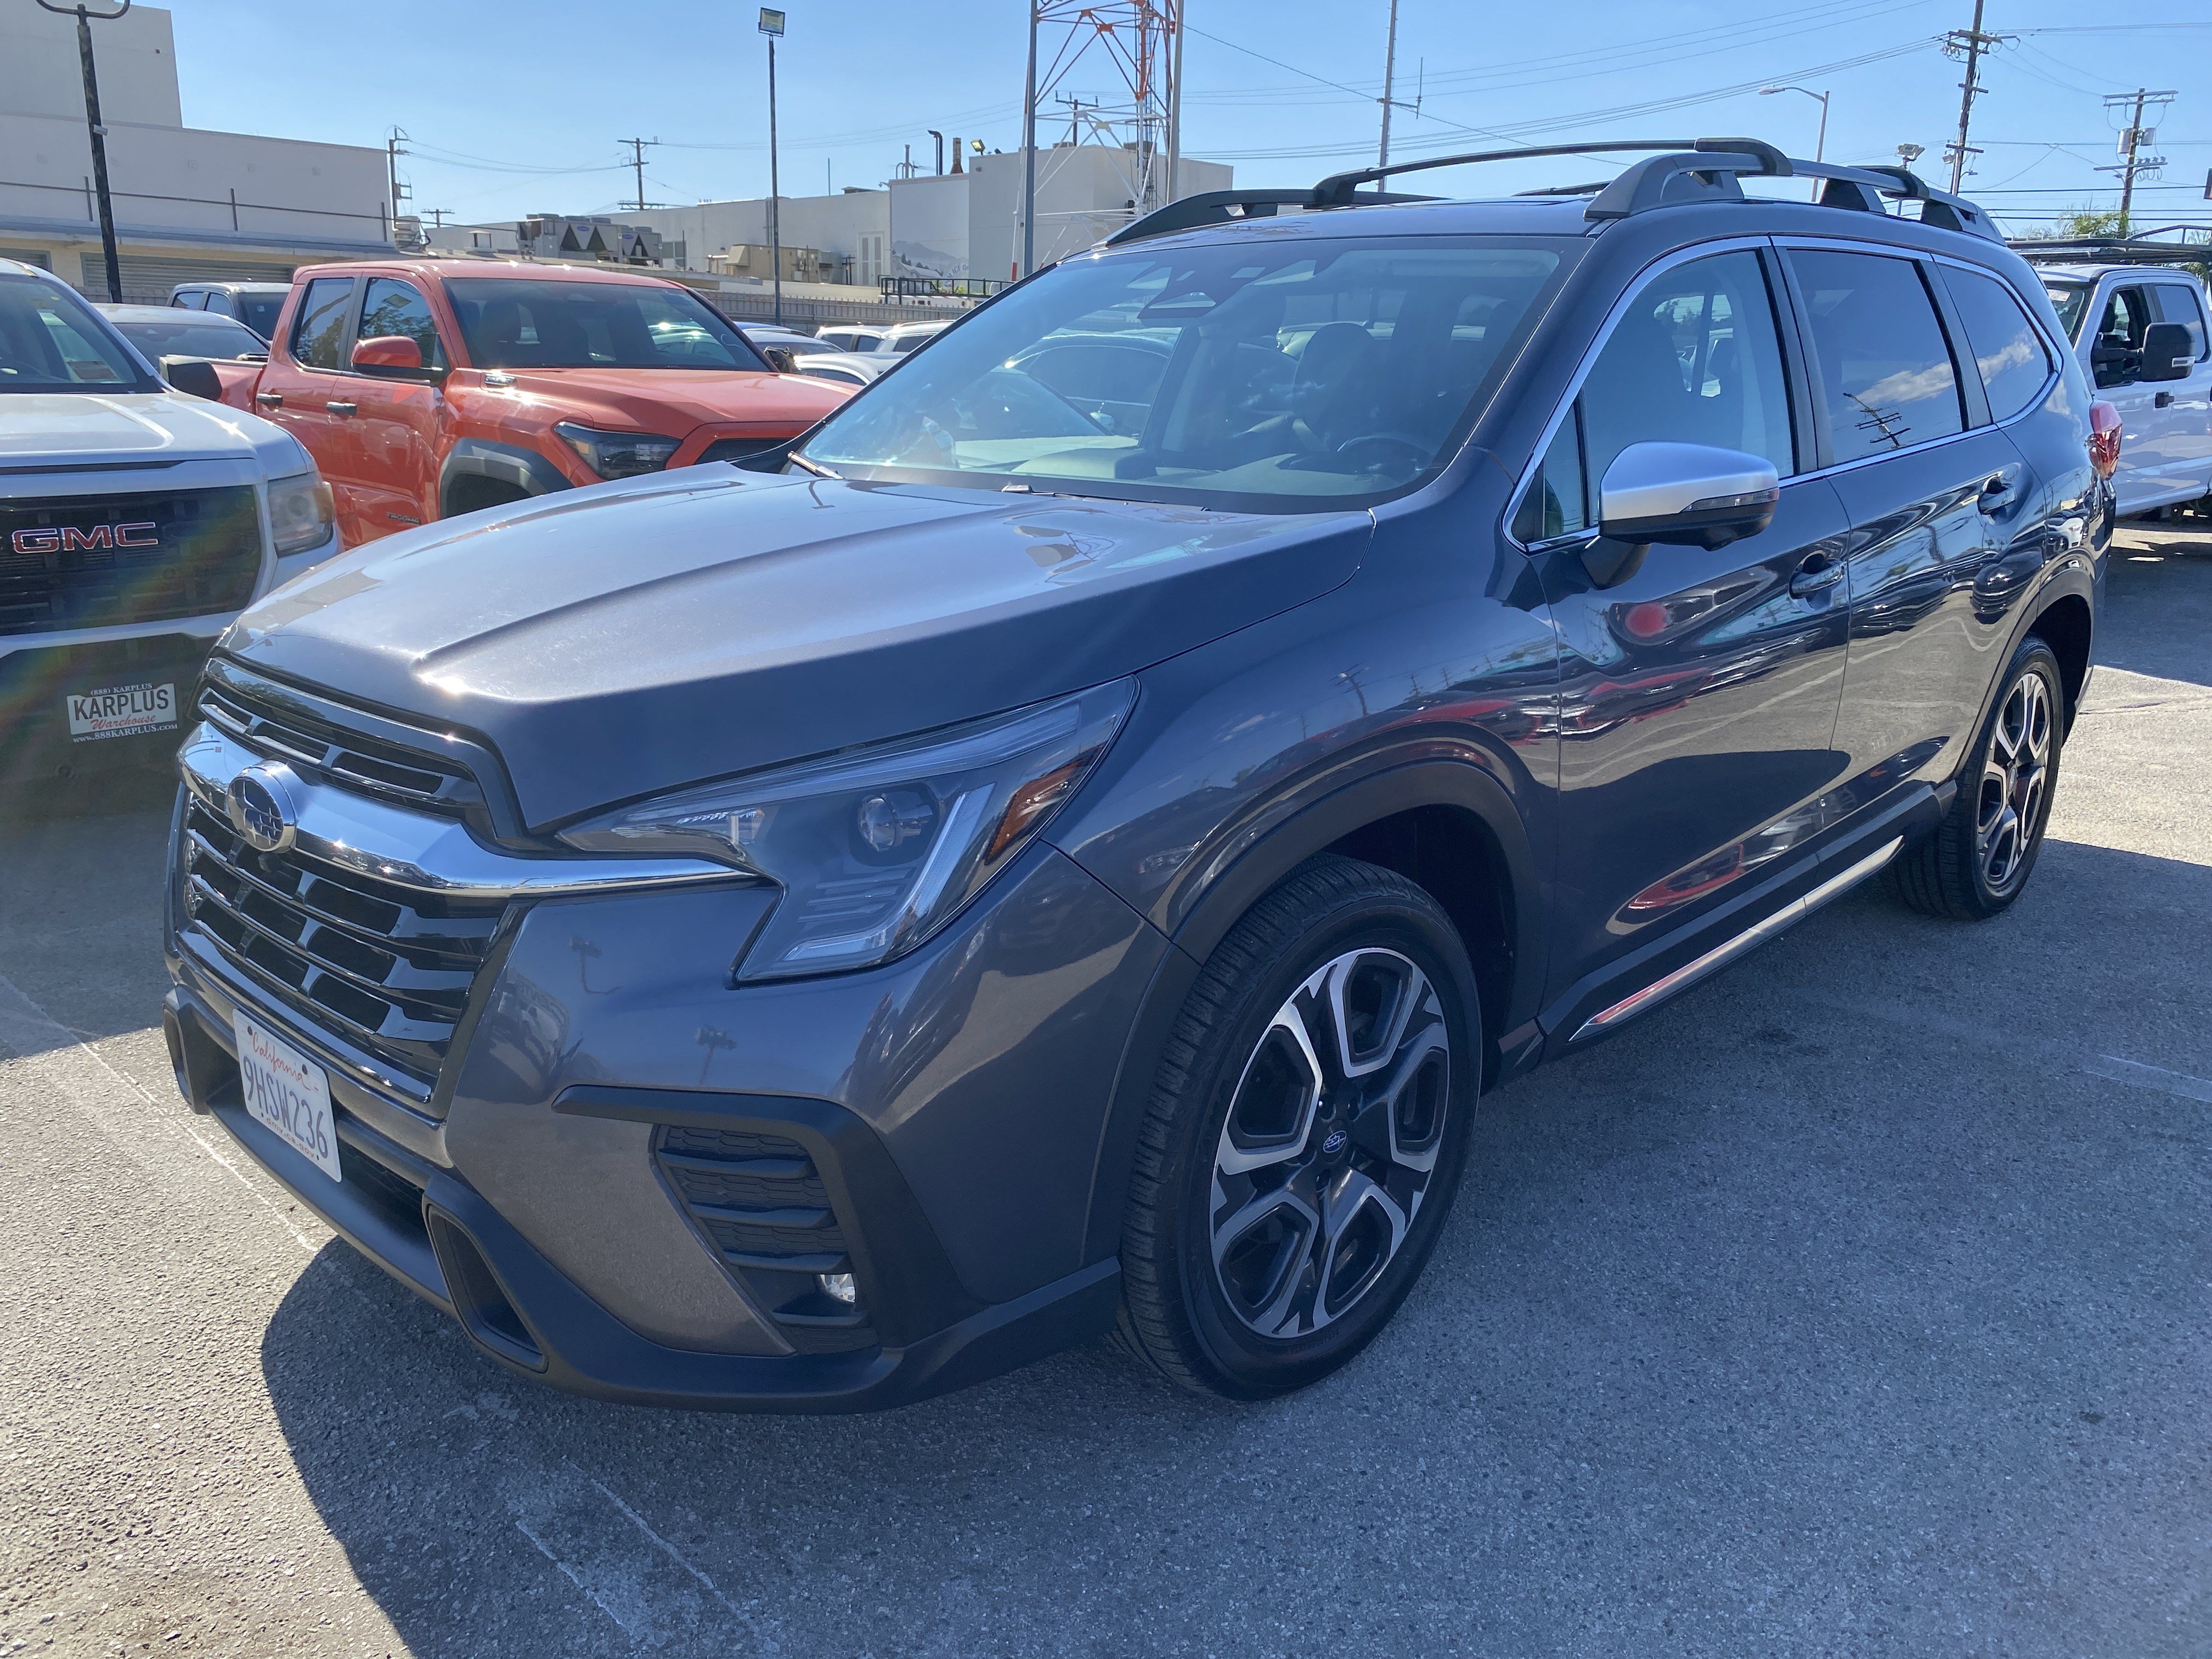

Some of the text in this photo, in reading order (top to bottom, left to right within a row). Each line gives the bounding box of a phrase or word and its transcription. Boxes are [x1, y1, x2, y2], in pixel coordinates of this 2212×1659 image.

[12, 522, 159, 554] GMC
[113, 682, 153, 694] KARPLUS
[74, 689, 170, 721] KARPLUS
[90, 714, 157, 730] Warehouse
[252, 1031, 311, 1091] California
[243, 1056, 328, 1159] 9HSW236
[266, 1117, 315, 1158] dmv.ca.gov
